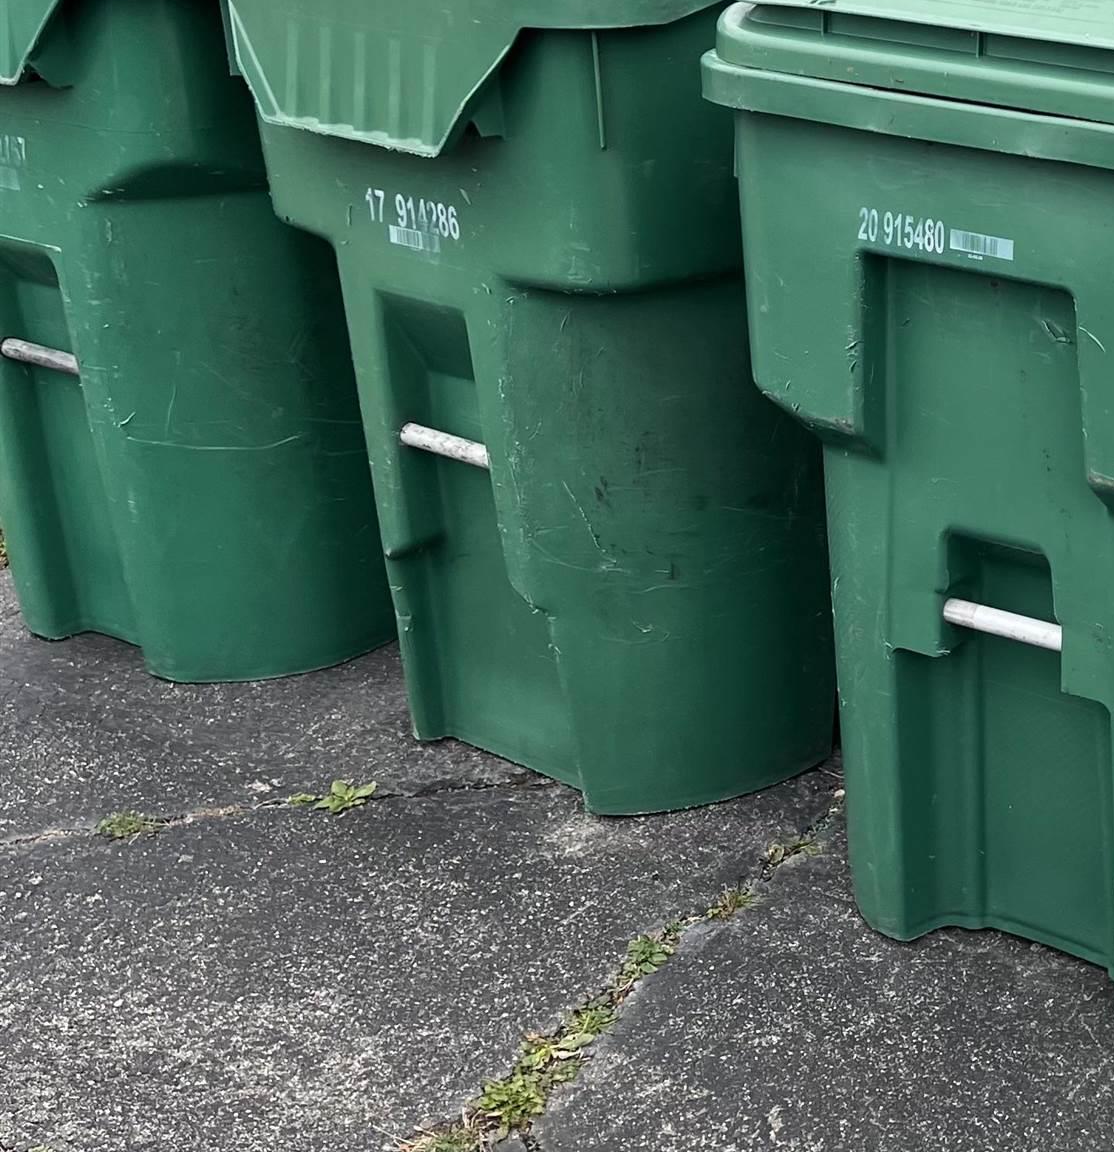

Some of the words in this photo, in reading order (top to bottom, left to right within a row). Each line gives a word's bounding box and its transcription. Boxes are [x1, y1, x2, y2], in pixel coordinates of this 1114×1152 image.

[365, 187, 385, 222] 17
[395, 193, 460, 240] 914286
[858, 207, 878, 242] 20
[883, 211, 945, 254] 915480
